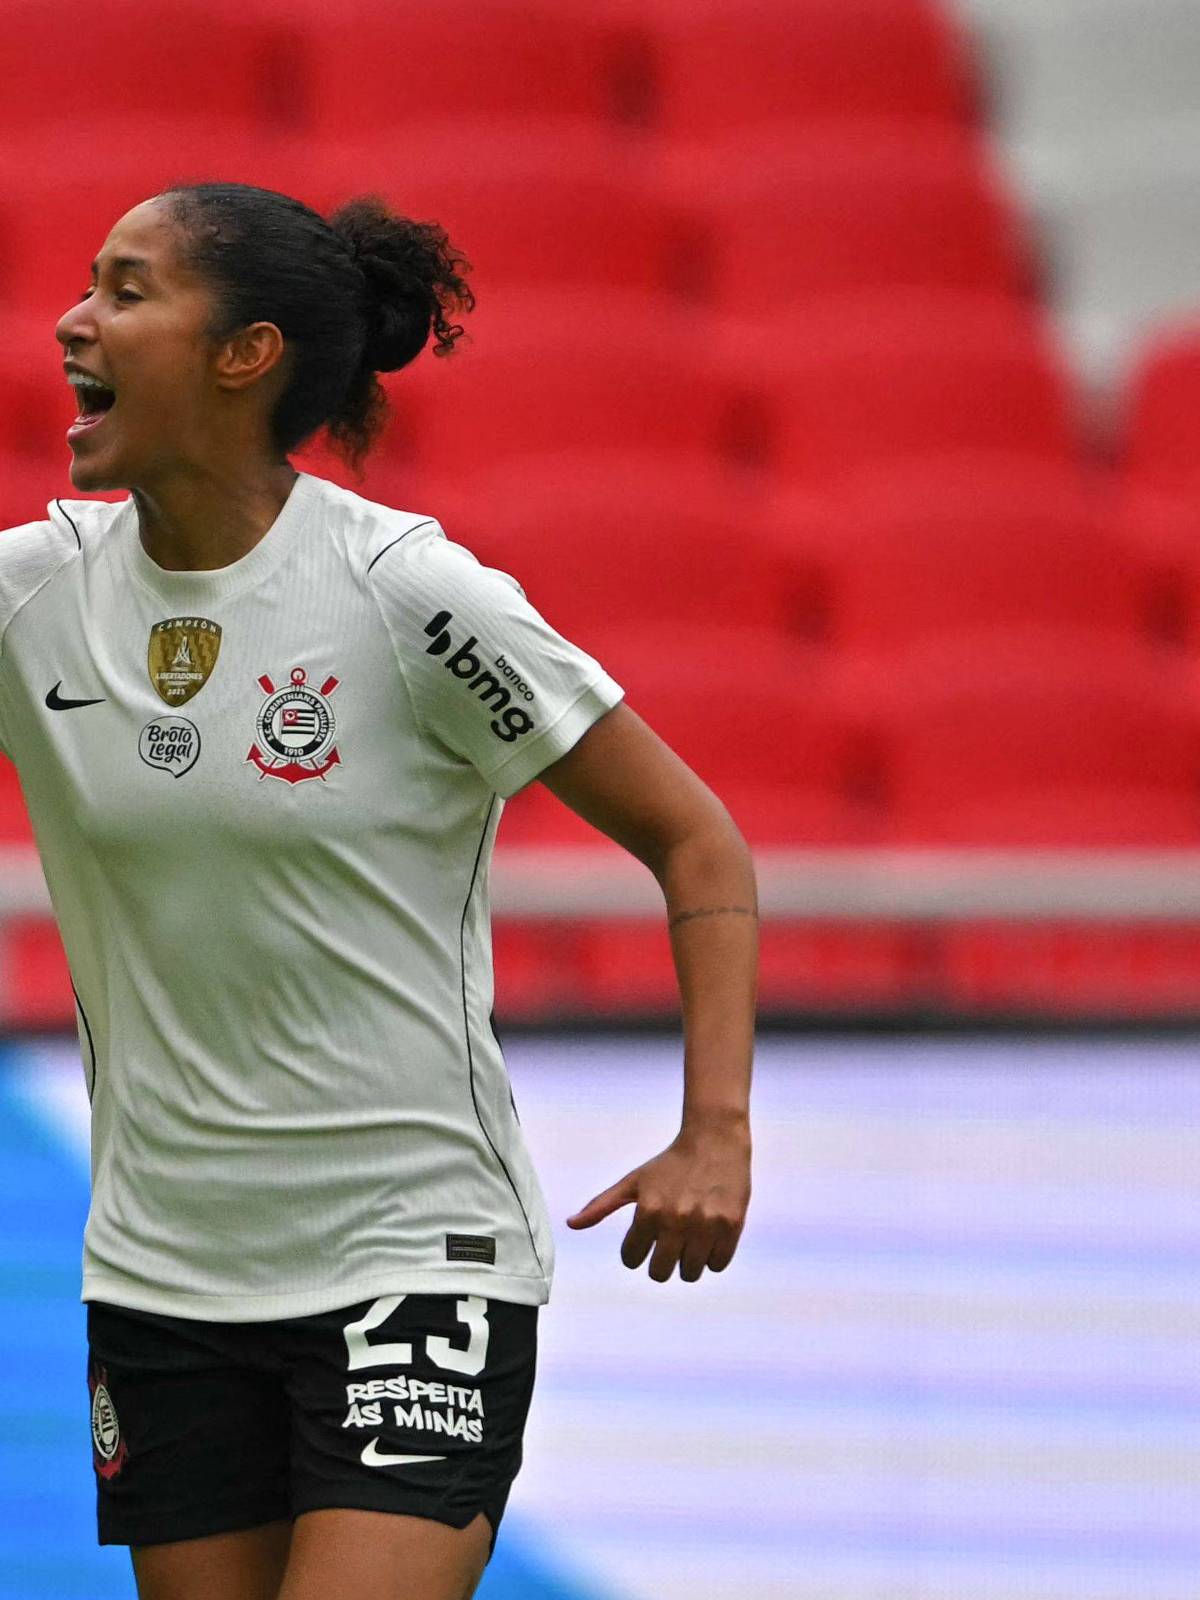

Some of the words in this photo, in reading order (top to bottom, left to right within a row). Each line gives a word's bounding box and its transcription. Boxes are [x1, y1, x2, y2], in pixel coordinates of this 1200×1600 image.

[444, 636, 534, 742] bmg
[495, 654, 534, 701] banco
[147, 725, 193, 743] Broto
[264, 693, 315, 724] CORINTHIANS
[314, 703, 328, 742] PAULISTA
[149, 741, 193, 763] Legal
[284, 747, 304, 756] 1910
[343, 1294, 490, 1376] 23
[346, 1375, 485, 1418] RESPEITA
[342, 1402, 384, 1428] AS
[393, 1403, 485, 1443] MINAS
